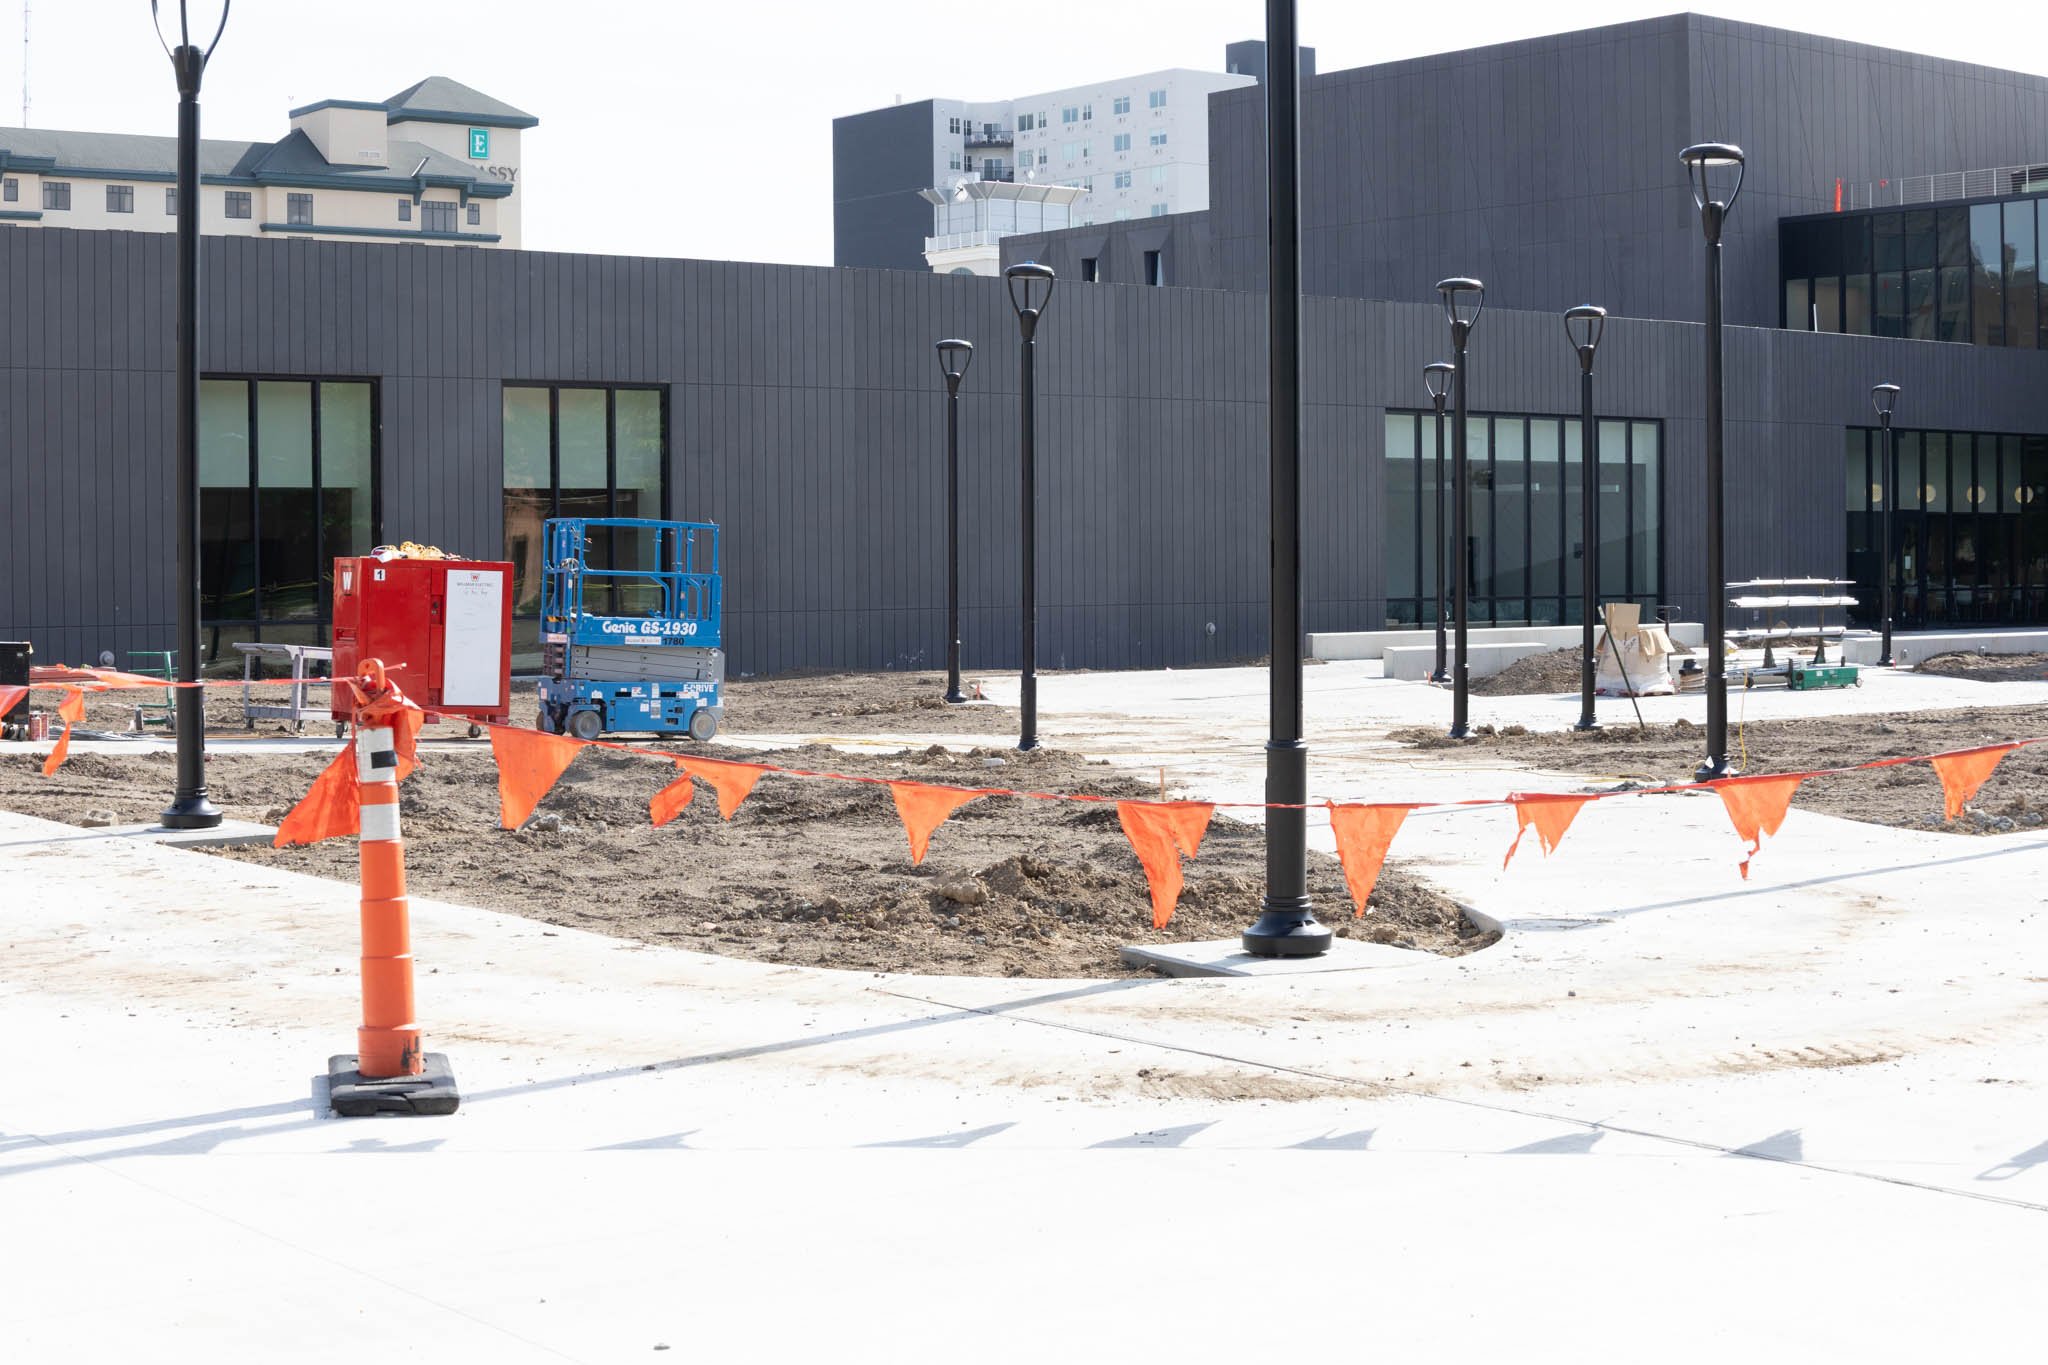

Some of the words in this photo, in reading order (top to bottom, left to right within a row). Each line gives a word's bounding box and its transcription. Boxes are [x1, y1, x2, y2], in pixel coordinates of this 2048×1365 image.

[474, 134, 485, 152] E
[343, 571, 353, 590] W
[602, 620, 637, 634] Genie
[640, 621, 698, 636] GS-1930
[663, 637, 684, 645] 1780
